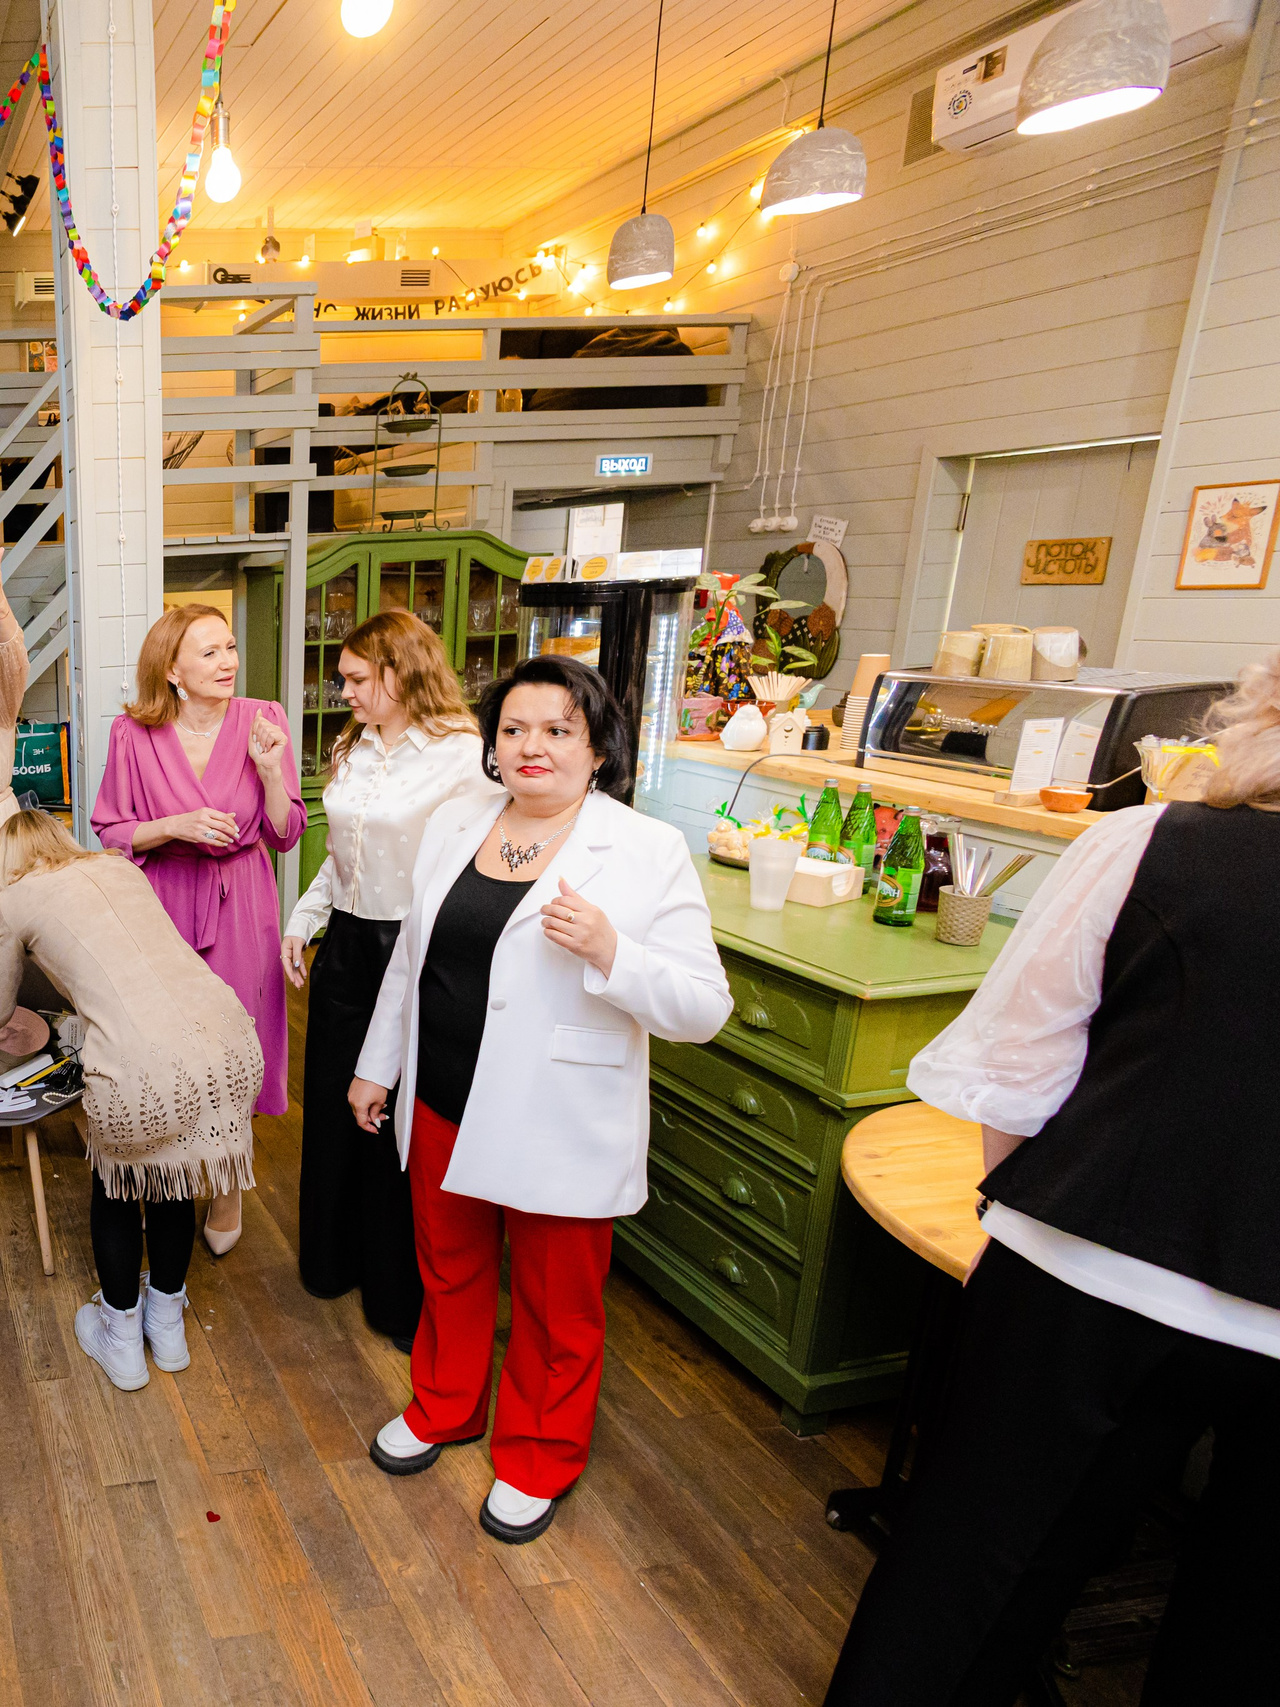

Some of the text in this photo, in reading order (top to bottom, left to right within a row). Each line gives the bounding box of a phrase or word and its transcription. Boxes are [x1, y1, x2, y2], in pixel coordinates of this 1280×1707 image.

[354, 304, 421, 321] ЖИЗНИ
[434, 262, 543, 317] РАДУЮСЬ
[601, 458, 646, 472] ВЫХОД
[1036, 542, 1097, 558] ПОТОК
[1026, 556, 1099, 575] ЧИСТОТЫ
[12, 763, 52, 776] БОСИБ
